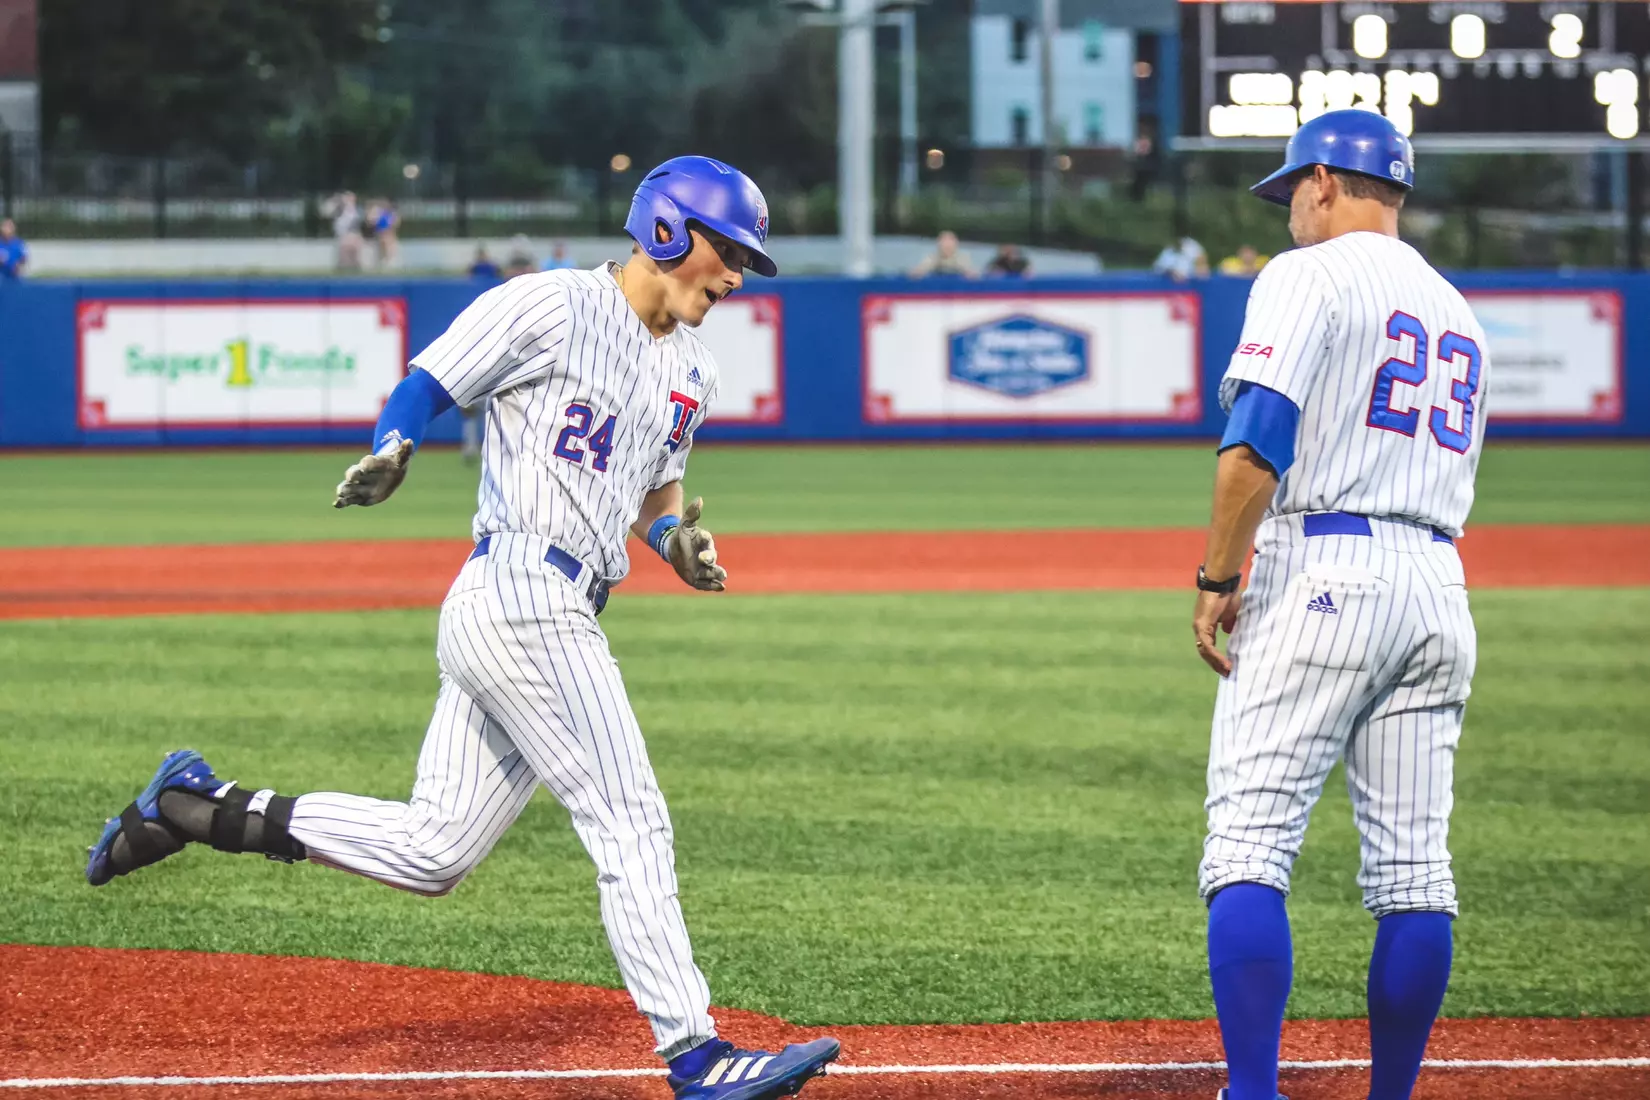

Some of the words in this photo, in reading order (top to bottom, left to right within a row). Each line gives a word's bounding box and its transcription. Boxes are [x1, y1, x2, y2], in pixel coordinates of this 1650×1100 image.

[224, 338, 254, 387] 1
[1365, 310, 1482, 455] 23
[552, 403, 617, 473] 24
